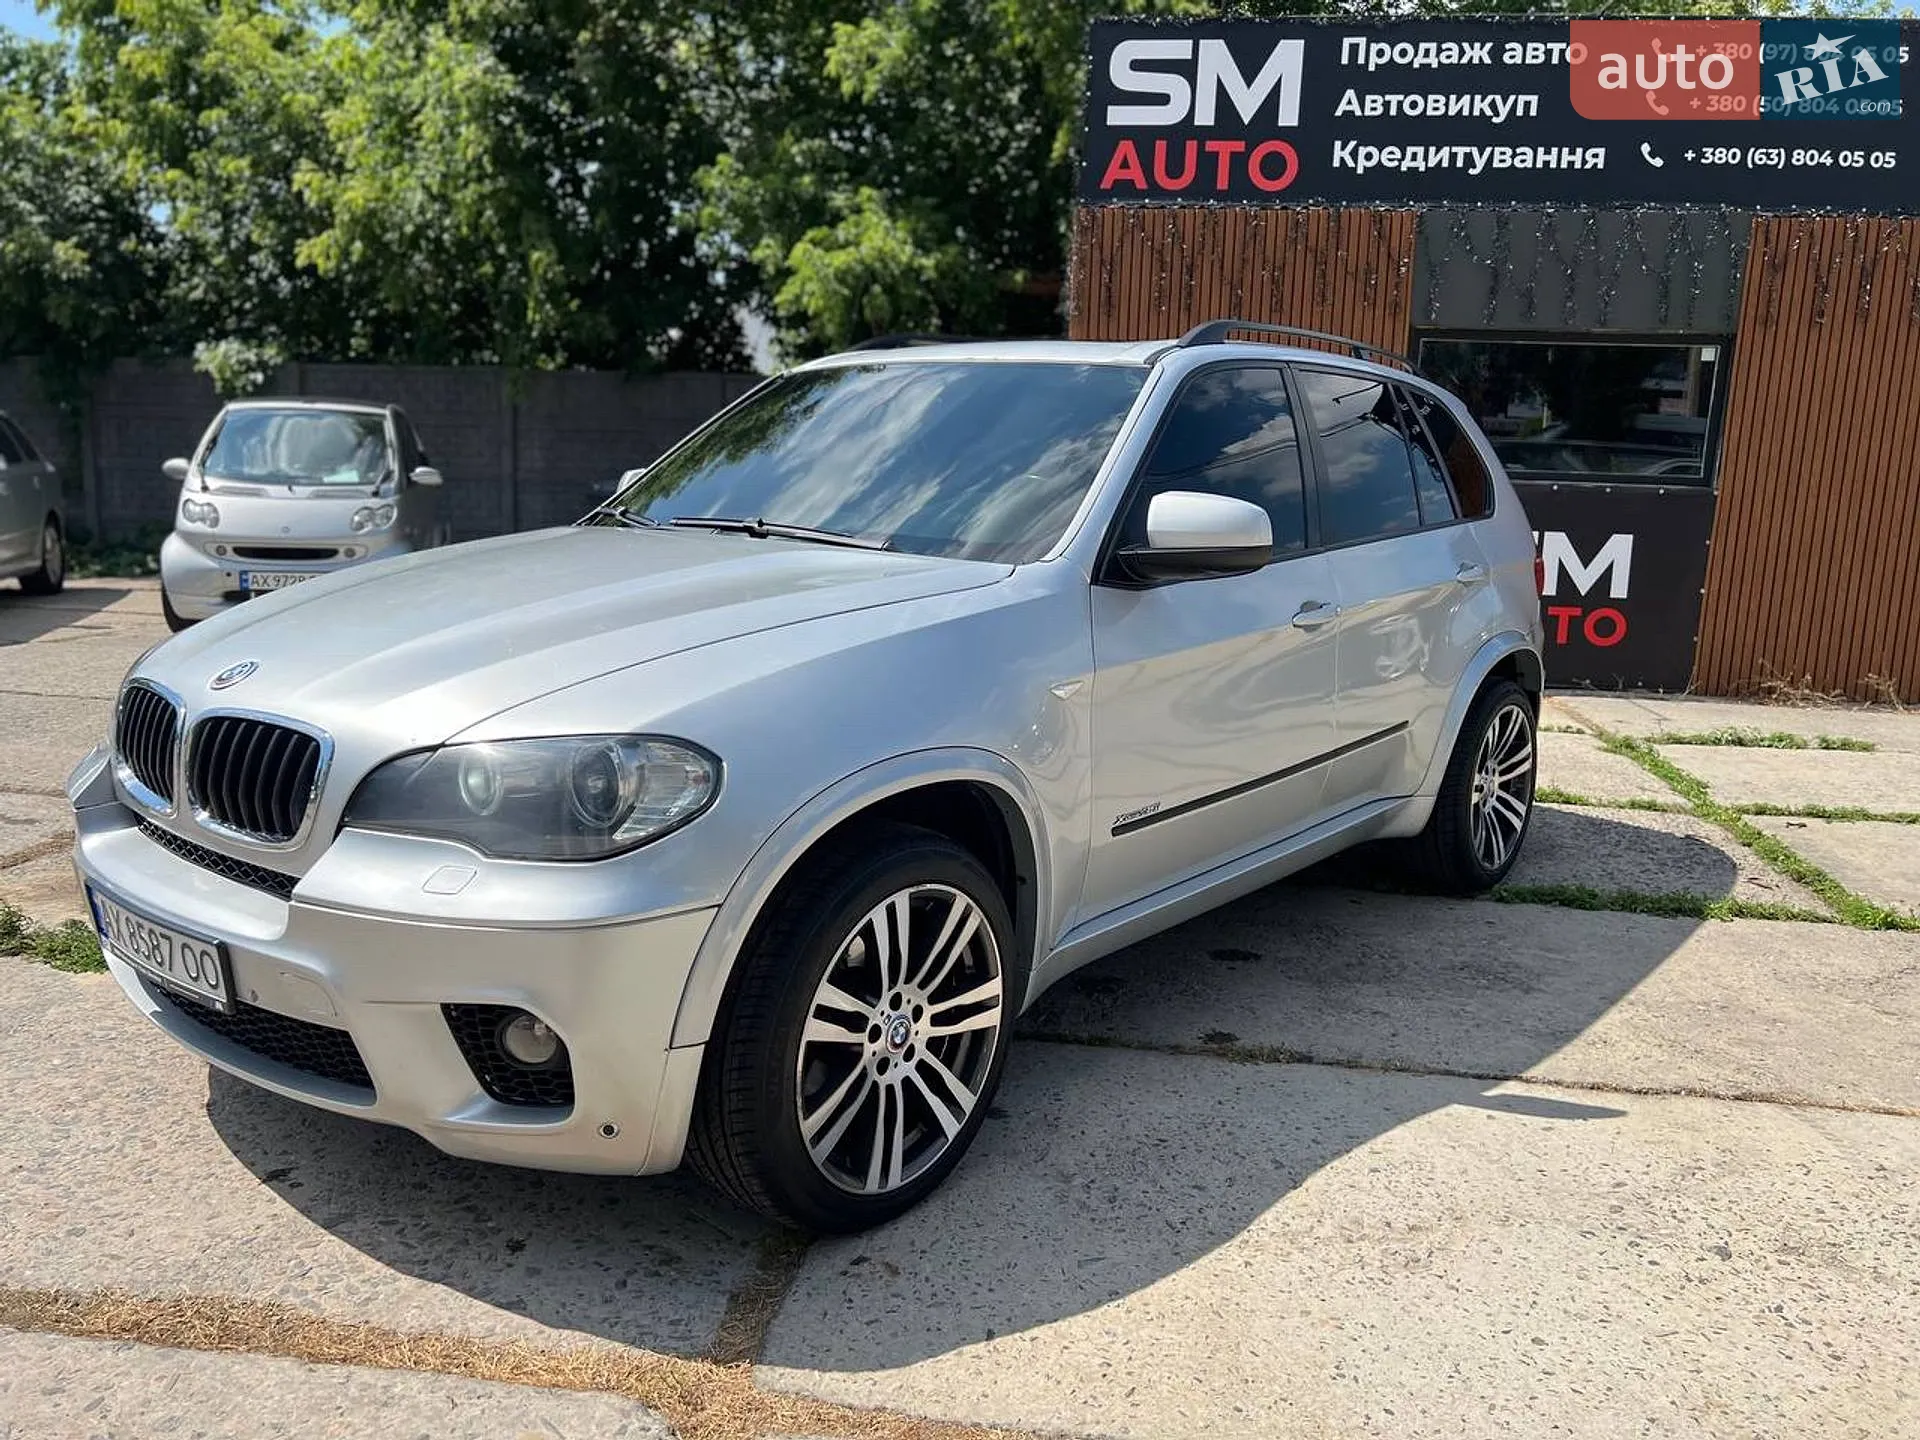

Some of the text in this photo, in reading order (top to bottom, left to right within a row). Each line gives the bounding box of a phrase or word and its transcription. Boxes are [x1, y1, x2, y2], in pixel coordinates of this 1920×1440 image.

[1341, 36, 1588, 71] Продаж авто
[1106, 38, 1305, 128] SM
[1334, 88, 1539, 124] Автовикуп
[1705, 94, 1747, 112] 380
[1100, 139, 1299, 192] AUTO
[1332, 139, 1606, 175] Кредитування
[1700, 147, 1742, 165] 380
[1746, 147, 1786, 169] (63)
[1791, 149, 1834, 166] 804
[1838, 150, 1865, 167] 05
[1870, 151, 1897, 168] 05
[250, 574, 271, 587] AX
[1532, 531, 1634, 599] M
[1547, 606, 1628, 647] TO
[125, 915, 173, 972] 8587
